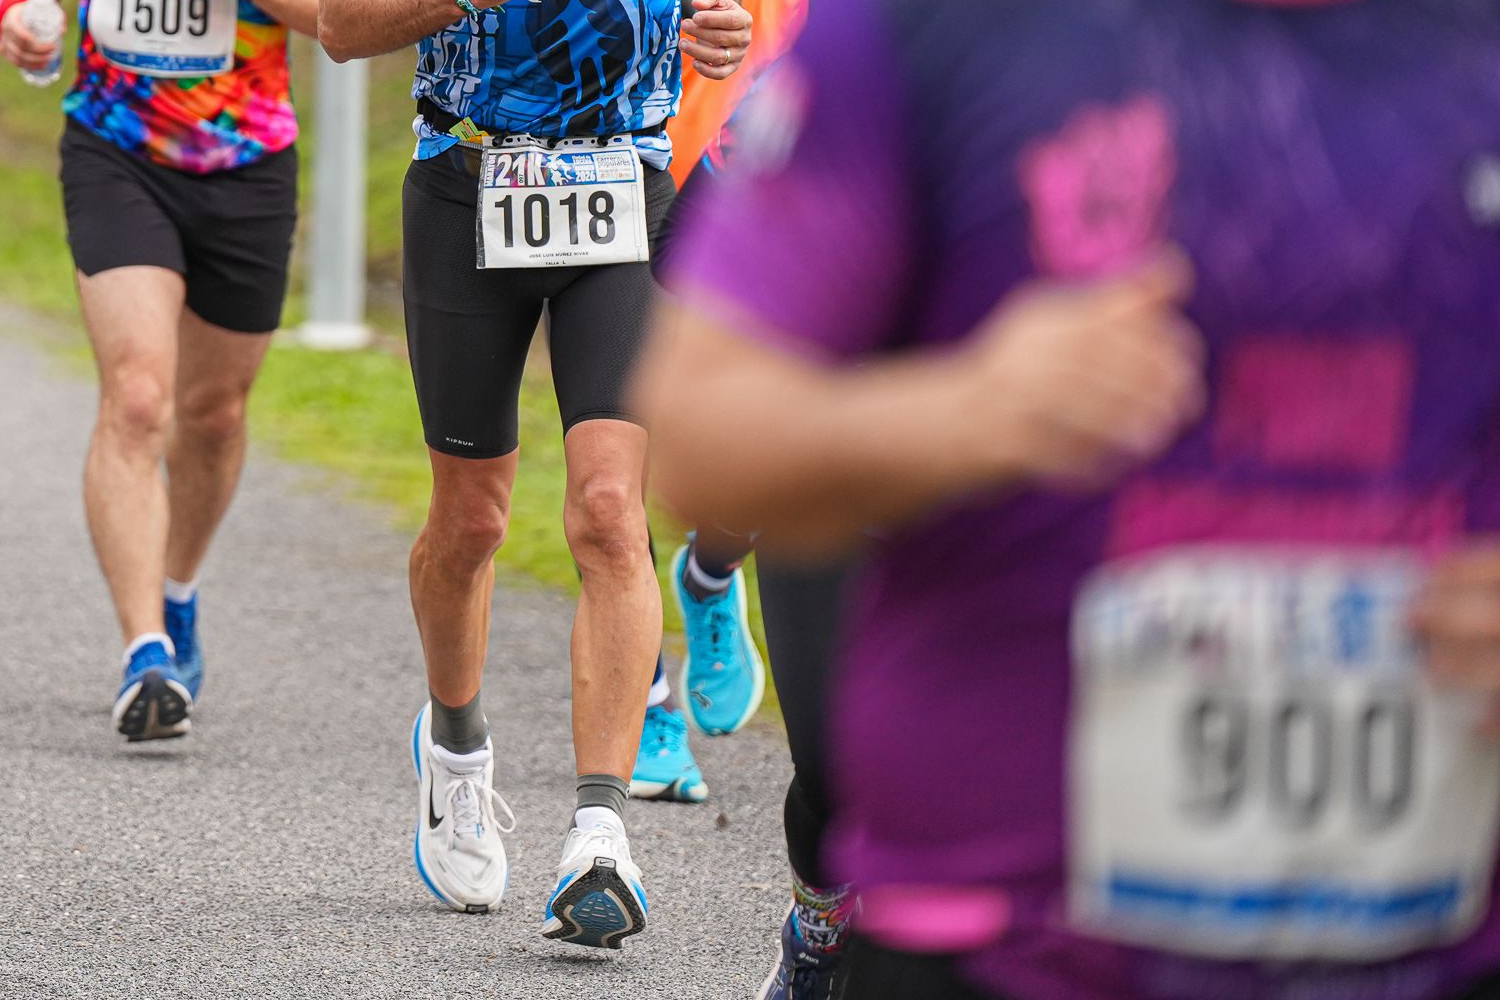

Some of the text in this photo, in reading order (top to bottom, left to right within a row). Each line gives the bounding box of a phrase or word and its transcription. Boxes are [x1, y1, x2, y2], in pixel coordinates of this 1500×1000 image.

[495, 153, 546, 187] 21K
[494, 190, 616, 248] 1018
[445, 436, 474, 447] KIPRUN
[1179, 696, 1417, 833] 900
